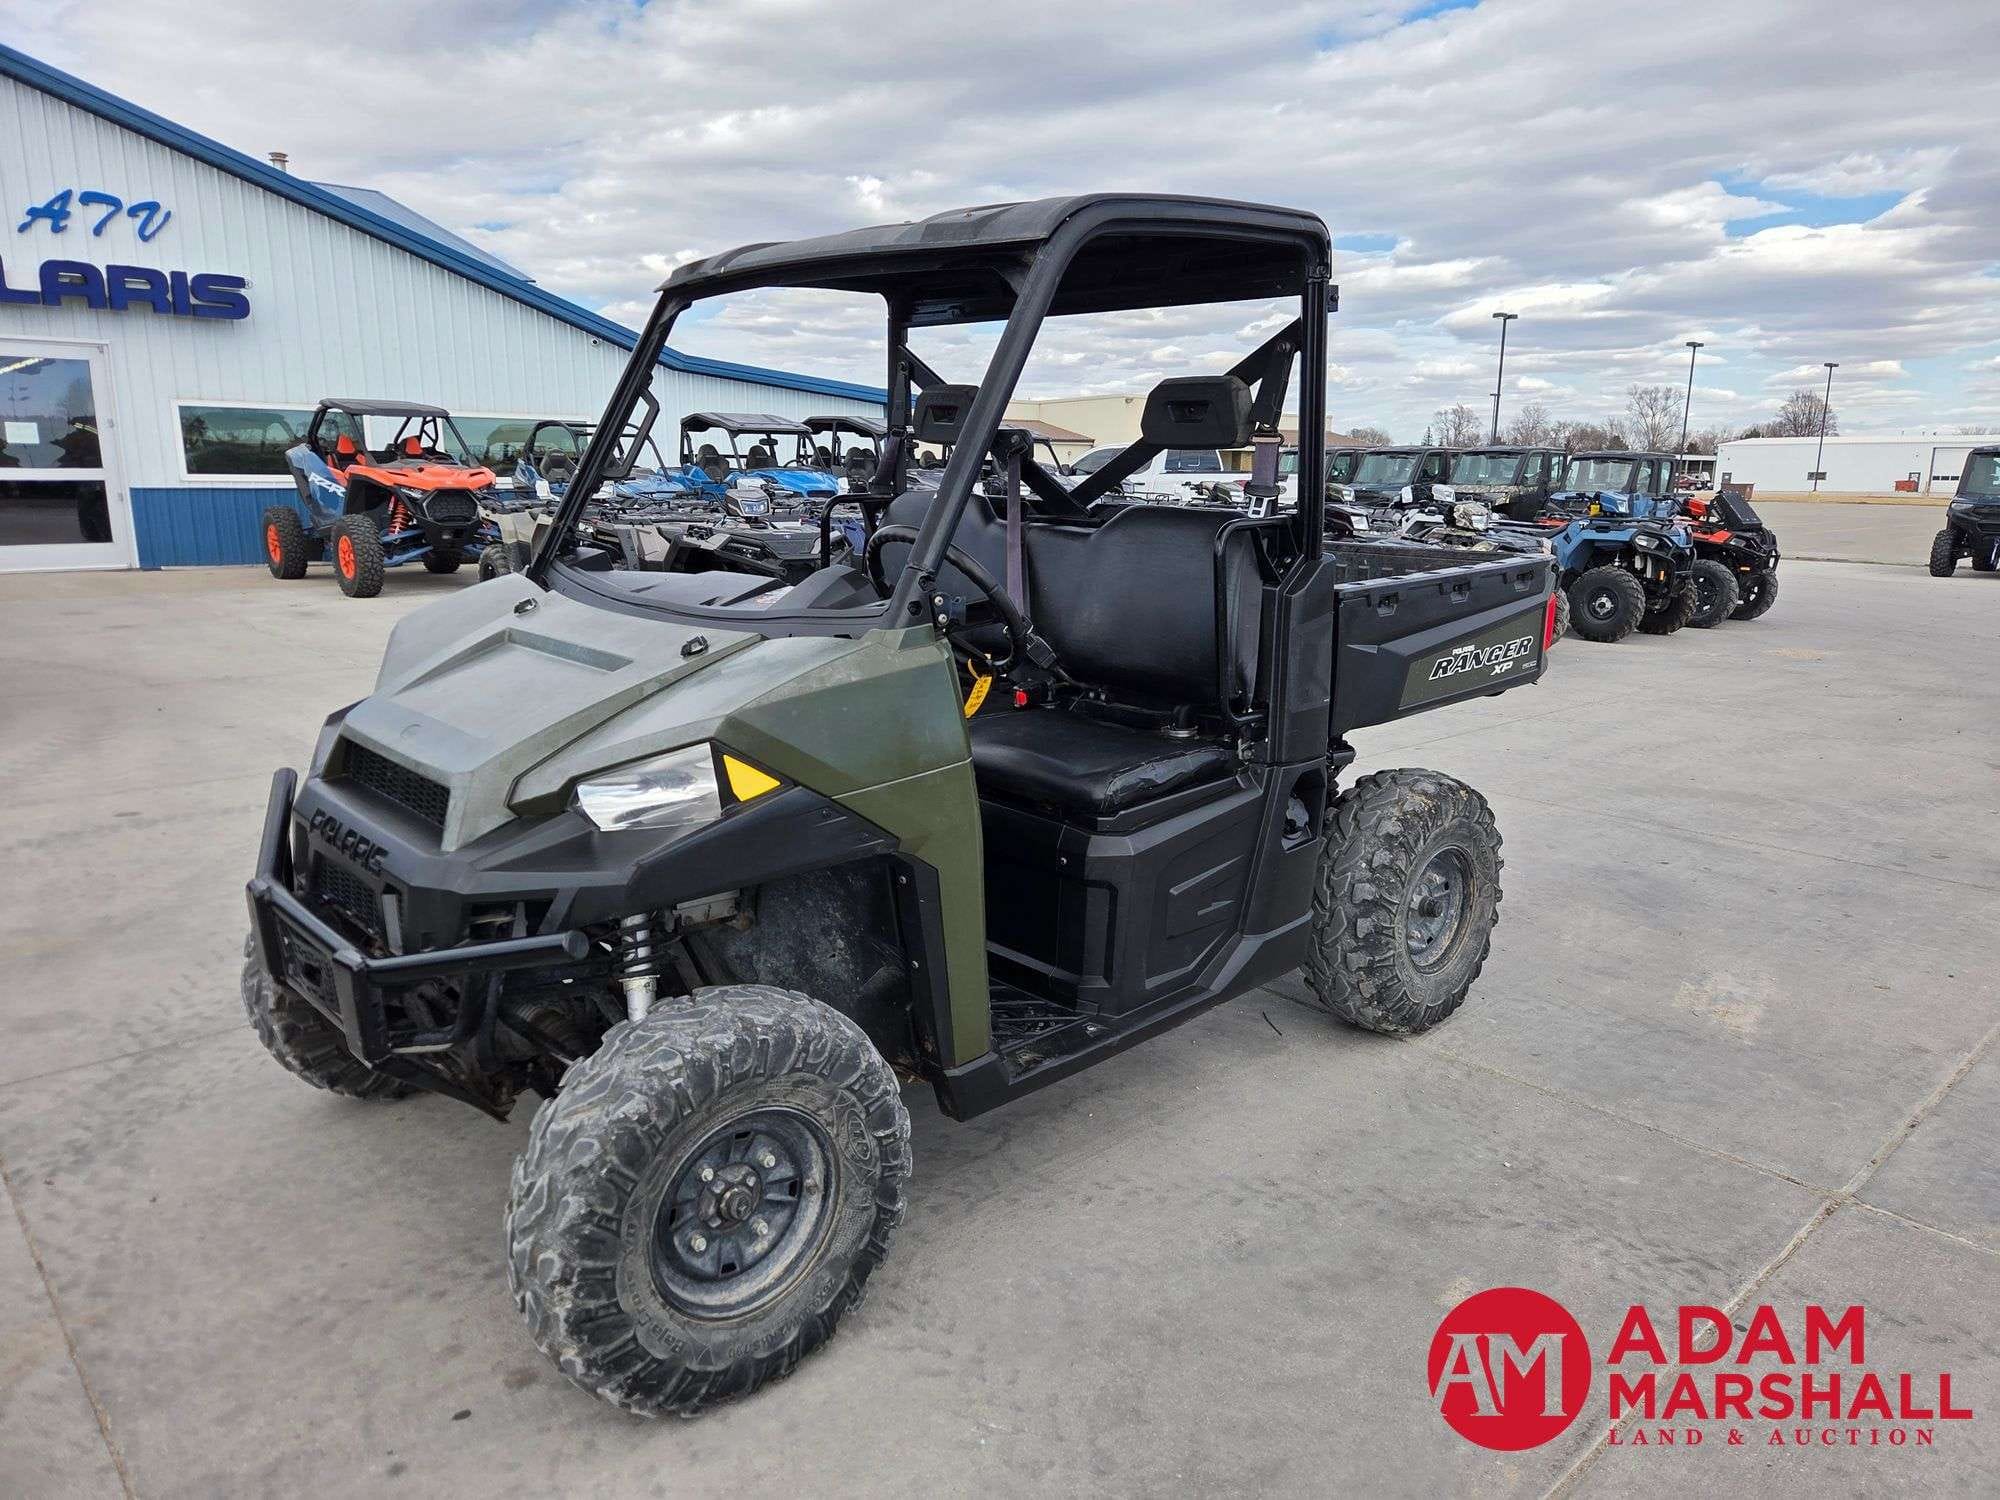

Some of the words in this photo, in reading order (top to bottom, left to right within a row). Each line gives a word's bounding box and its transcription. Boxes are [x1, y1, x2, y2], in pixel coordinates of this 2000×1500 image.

[17, 188, 172, 242] ATV
[309, 472, 346, 498] RZR
[1429, 636, 1533, 680] RANGER
[1490, 661, 1513, 676] XP
[310, 807, 389, 873] POLARIS
